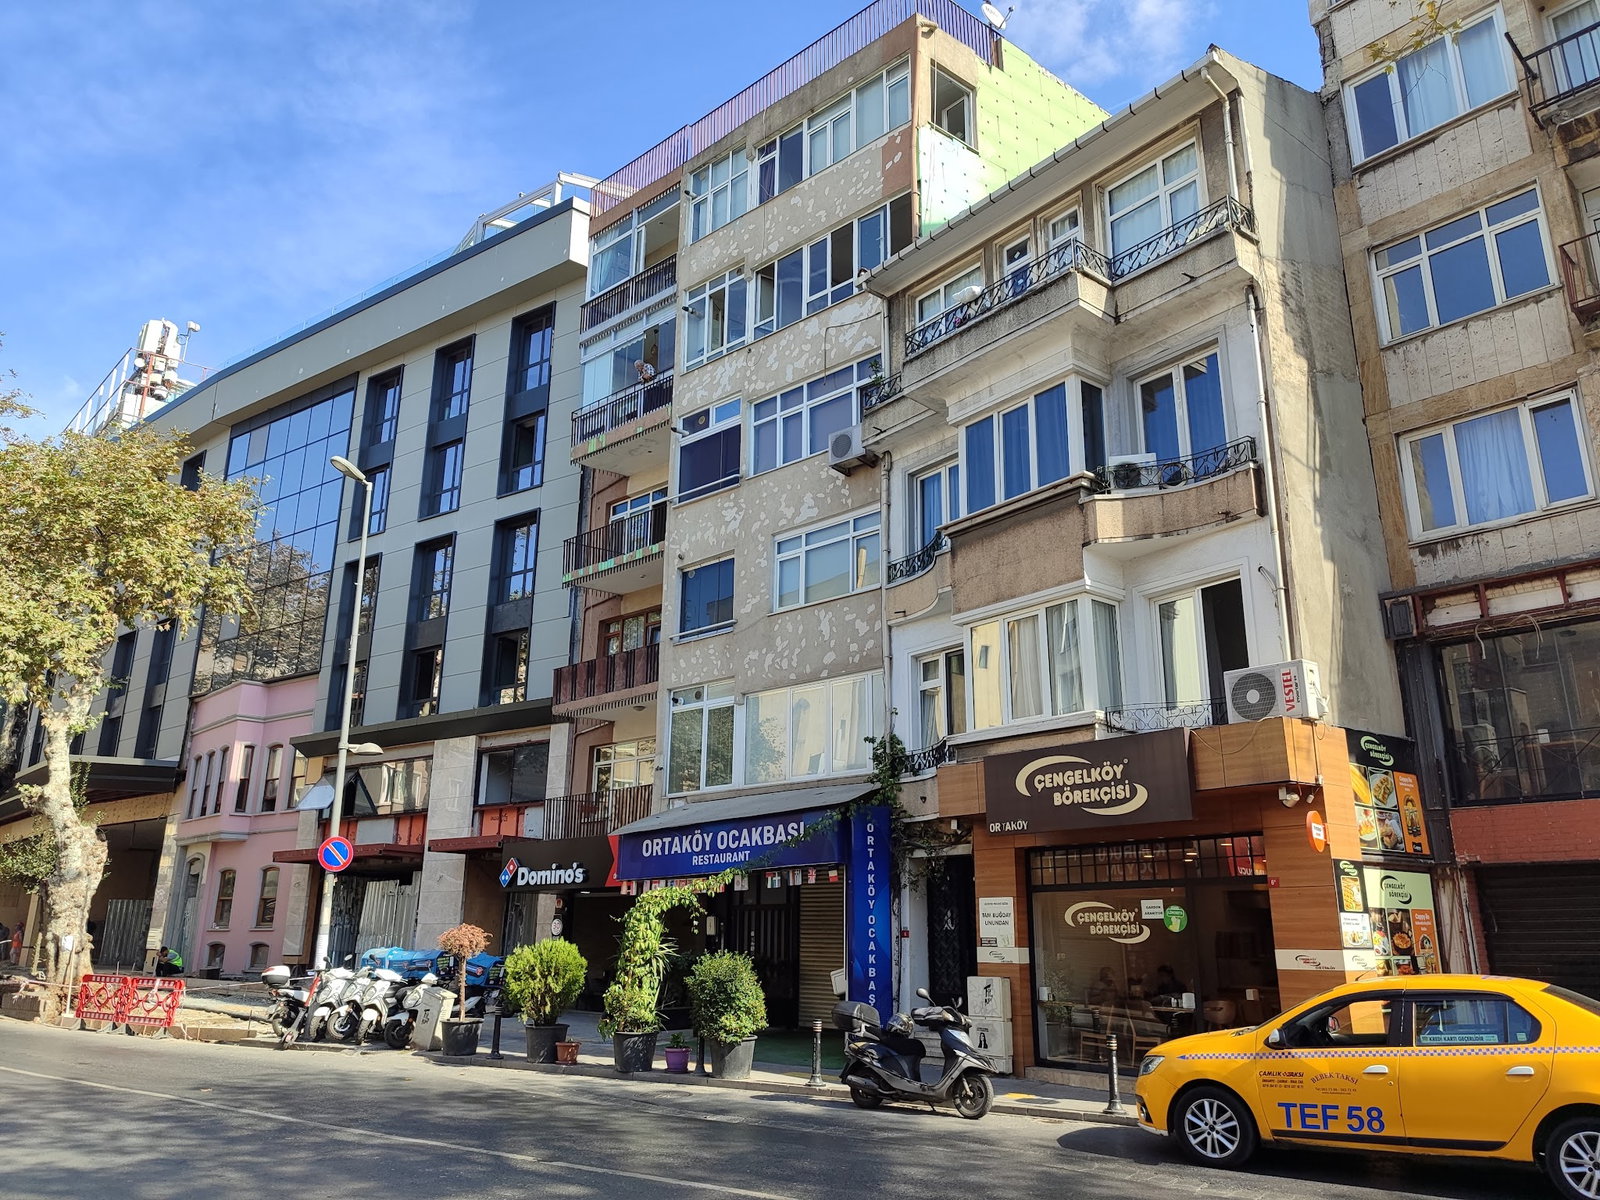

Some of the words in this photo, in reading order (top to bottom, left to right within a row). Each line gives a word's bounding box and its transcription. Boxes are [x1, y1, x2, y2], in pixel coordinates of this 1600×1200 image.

[1281, 668, 1296, 712] VESTEL
[1033, 761, 1124, 793] ÇENGELKÖY
[1053, 780, 1131, 806] BÖREKÇİSİ
[989, 818, 1029, 833] ORTAKÖY
[642, 829, 713, 857] ORTAKÖY
[692, 850, 751, 866] RESTAURANT
[866, 823, 876, 909] ORTAKÖY
[517, 862, 587, 886] Domino's
[1076, 908, 1136, 925] ÇENGELKÖY
[1089, 922, 1140, 936] BÖREKÇİSİ
[1310, 1072, 1335, 1084] BEBEK
[1277, 1101, 1339, 1130] TEF
[1346, 1105, 1386, 1133] 58
